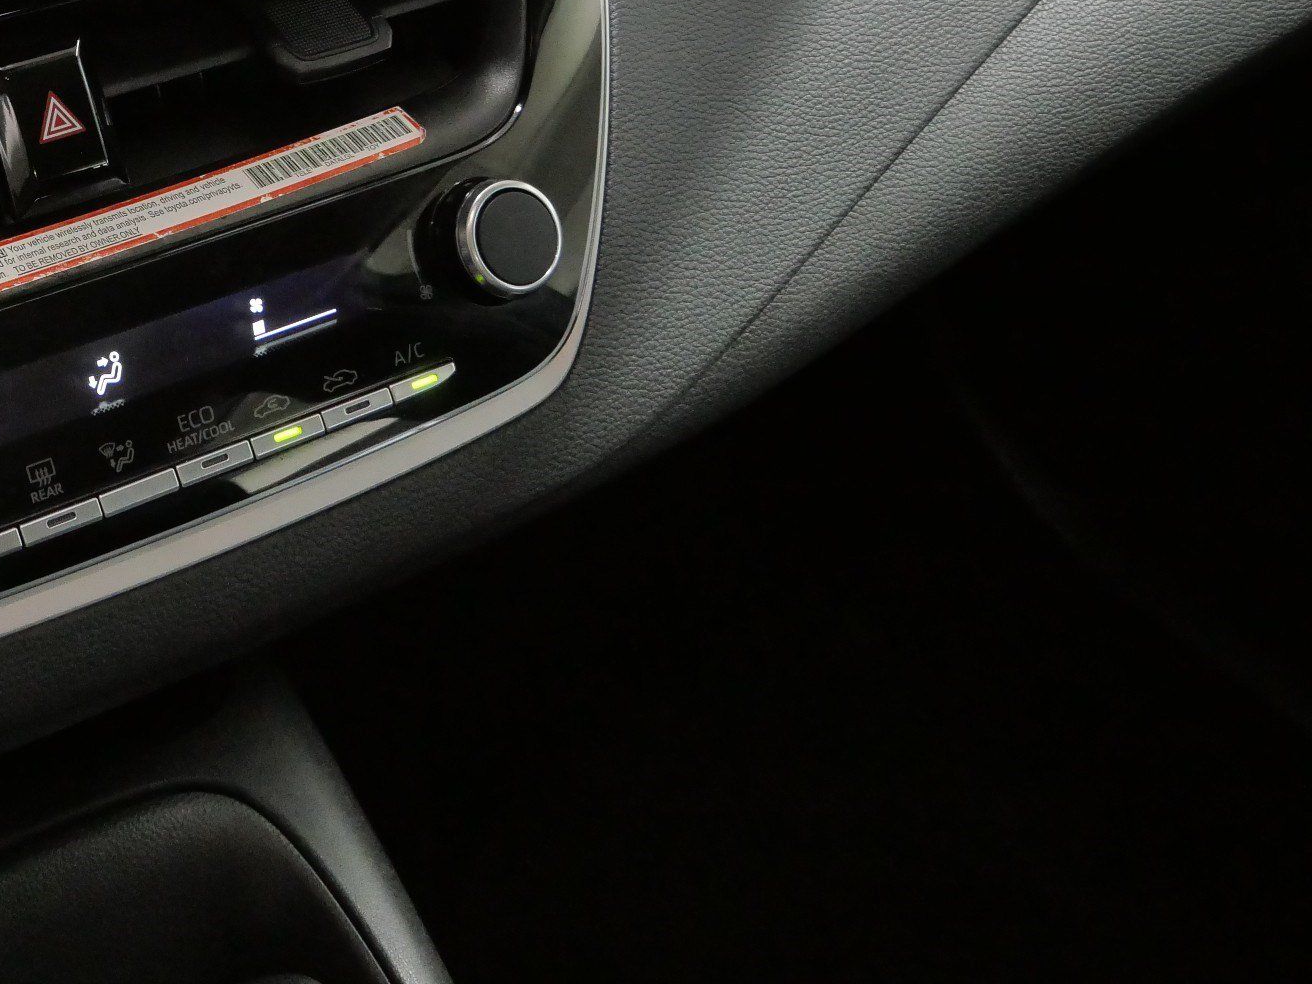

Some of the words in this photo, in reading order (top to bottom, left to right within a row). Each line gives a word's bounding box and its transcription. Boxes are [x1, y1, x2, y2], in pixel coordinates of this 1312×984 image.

[6, 243, 26, 252] Your
[27, 234, 55, 247] vehicle
[55, 222, 92, 238] wirelessly
[92, 211, 128, 226] transmits
[126, 201, 160, 214] location,
[159, 192, 185, 203] driving
[185, 185, 200, 195] and
[200, 178, 226, 190] vehicle
[4, 257, 15, 265] for
[16, 246, 46, 261] internal
[47, 236, 81, 251] research
[82, 230, 97, 240] and
[97, 225, 115, 235] data
[147, 209, 164, 218] See
[13, 264, 26, 273] TO
[26, 260, 38, 269] BE
[38, 247, 78, 265] REMOVED
[77, 243, 89, 252] BY
[89, 234, 121, 248] OWNER
[119, 226, 140, 238] ONLY
[395, 342, 425, 367] A/C
[176, 405, 215, 433] ECO
[166, 420, 235, 454] HEAT/COOL
[30, 482, 64, 504] REAR
